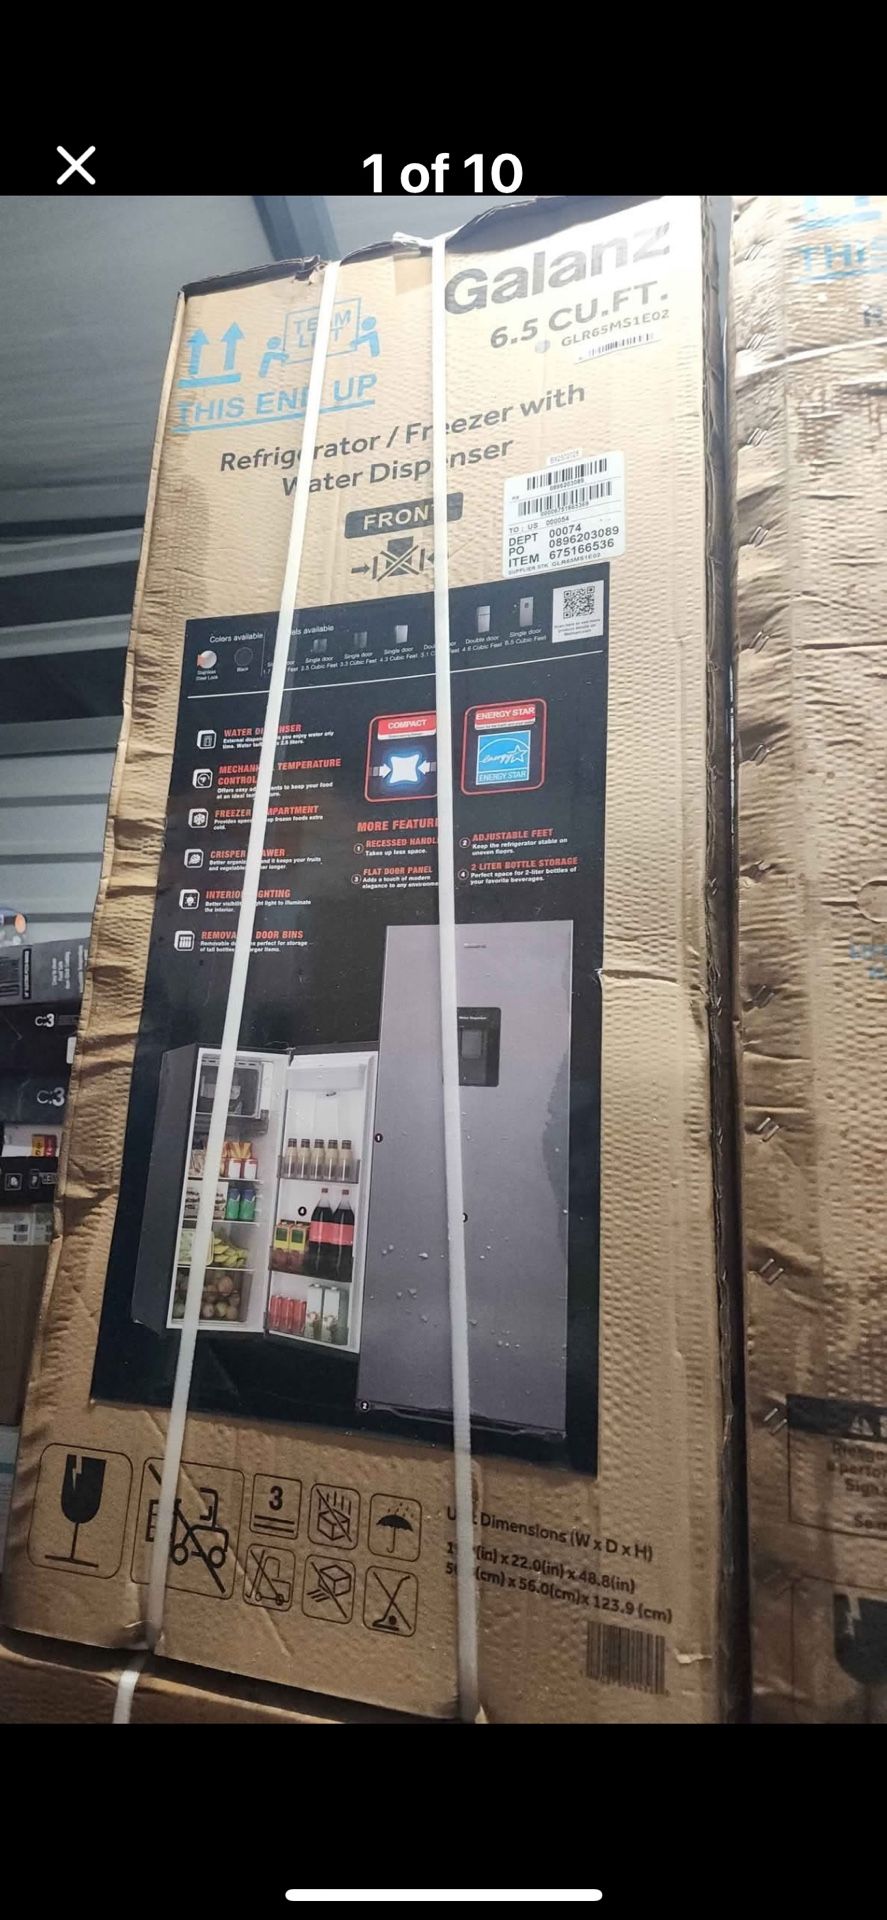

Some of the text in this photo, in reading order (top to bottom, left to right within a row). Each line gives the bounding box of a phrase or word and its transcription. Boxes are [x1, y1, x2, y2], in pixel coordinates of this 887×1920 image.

[444, 222, 670, 315] Galanz
[293, 309, 352, 333] TEM
[490, 280, 668, 349] 6.5 CU.FT.
[177, 396, 244, 422] THIS
[333, 373, 378, 401] UP
[220, 434, 380, 472] Refrigrator
[405, 405, 514, 444] Frezer
[520, 384, 586, 417] with
[370, 440, 515, 484] Dispnser
[528, 522, 539, 530] US
[508, 523, 582, 547] DEPT 00074
[508, 526, 620, 556] PO 0896203089
[508, 538, 615, 568] ITEM 675166536
[303, 624, 335, 635] available
[209, 632, 264, 644] Colors available
[476, 707, 535, 720] ENERGY STAR
[387, 719, 428, 730] COMPACT
[223, 728, 253, 737] WATER
[277, 758, 341, 771] TEMPERATURE
[218, 775, 257, 786] CONTROL
[480, 771, 527, 782] ENERGY STAR
[214, 809, 252, 818] FREEZER
[356, 821, 389, 832] MORE
[472, 828, 554, 841] ADJUSTABLE FEET
[366, 837, 439, 848] RECESSED HANDL
[501, 840, 537, 848] refrigerator
[210, 850, 246, 859] CRISPER
[471, 857, 578, 871] 2 LITER BOTTLE STORAGE
[363, 866, 433, 876] FLAT DOOR PANEL
[255, 930, 304, 939] DOOR BINS
[269, 1485, 283, 1511] 3
[481, 1512, 654, 1563] Dimensions (W x D x H)
[501, 1553, 636, 1595] x 22.0(in) x 48.8(in)
[508, 1577, 673, 1625] x 123.9 (cm)
